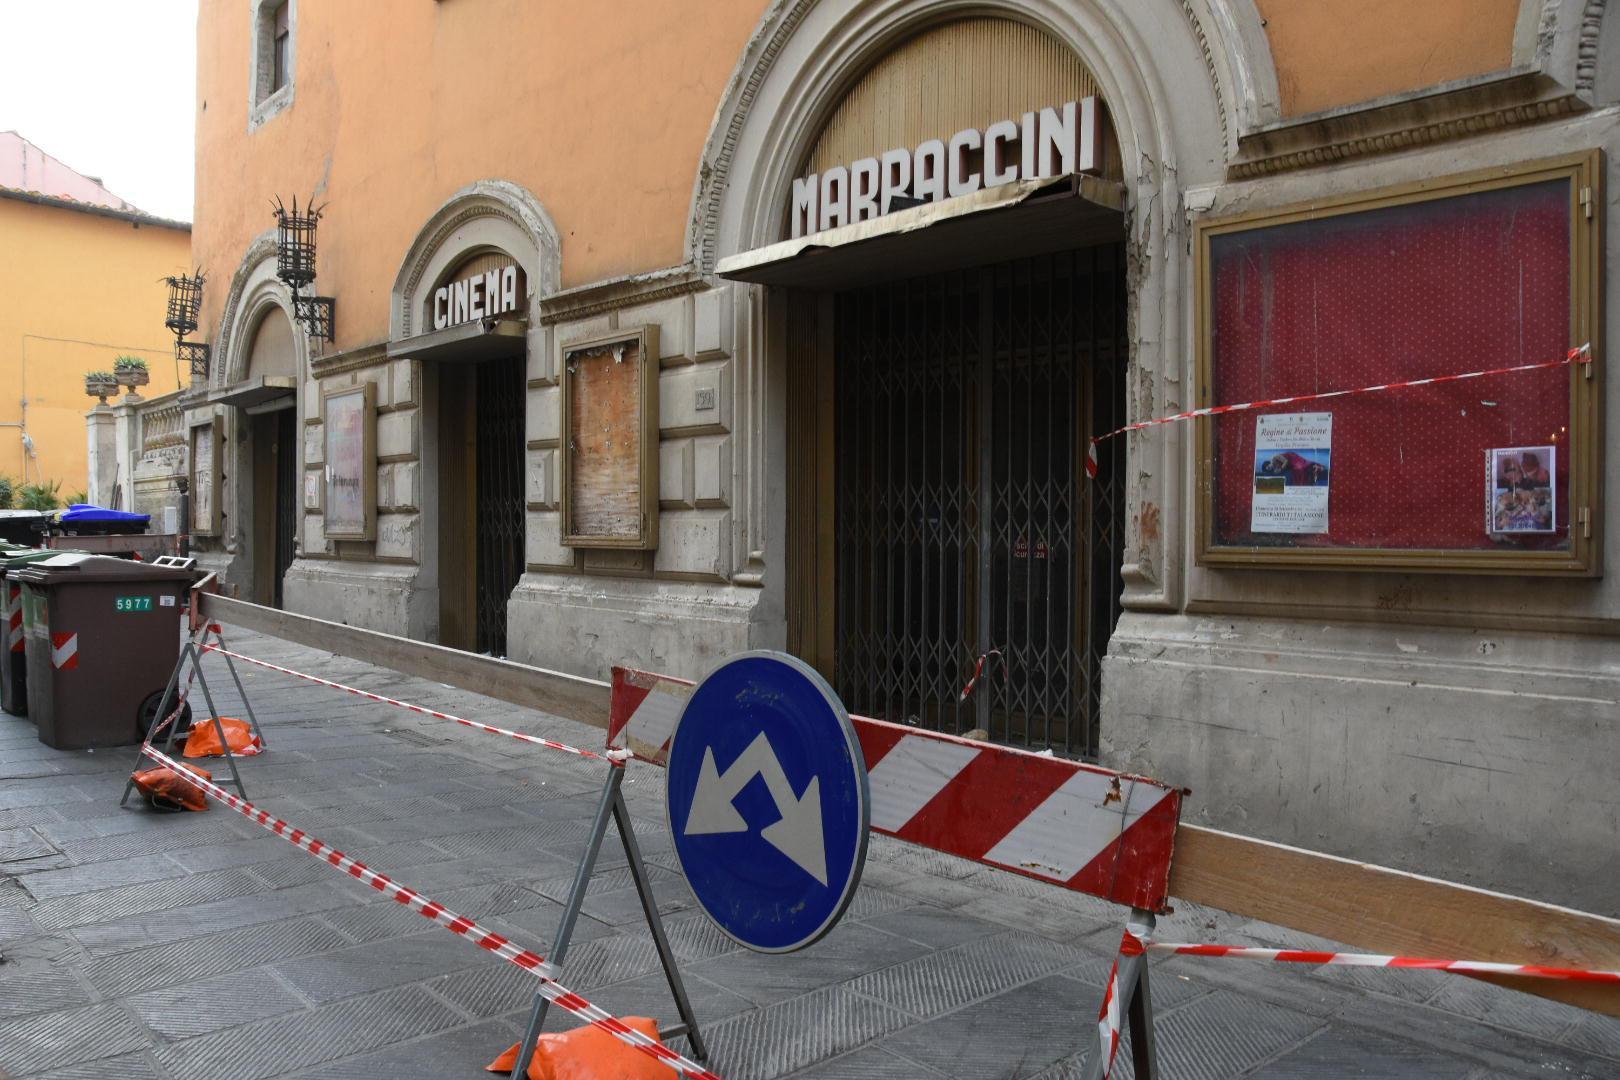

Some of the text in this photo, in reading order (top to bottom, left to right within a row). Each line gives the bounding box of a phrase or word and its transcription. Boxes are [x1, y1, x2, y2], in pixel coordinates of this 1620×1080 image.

[791, 95, 1098, 239] MARRACCINI
[434, 264, 517, 330] CINEMA
[1261, 427, 1285, 438] Regine
[1294, 426, 1328, 436] Passione
[117, 598, 150, 610] 5977
